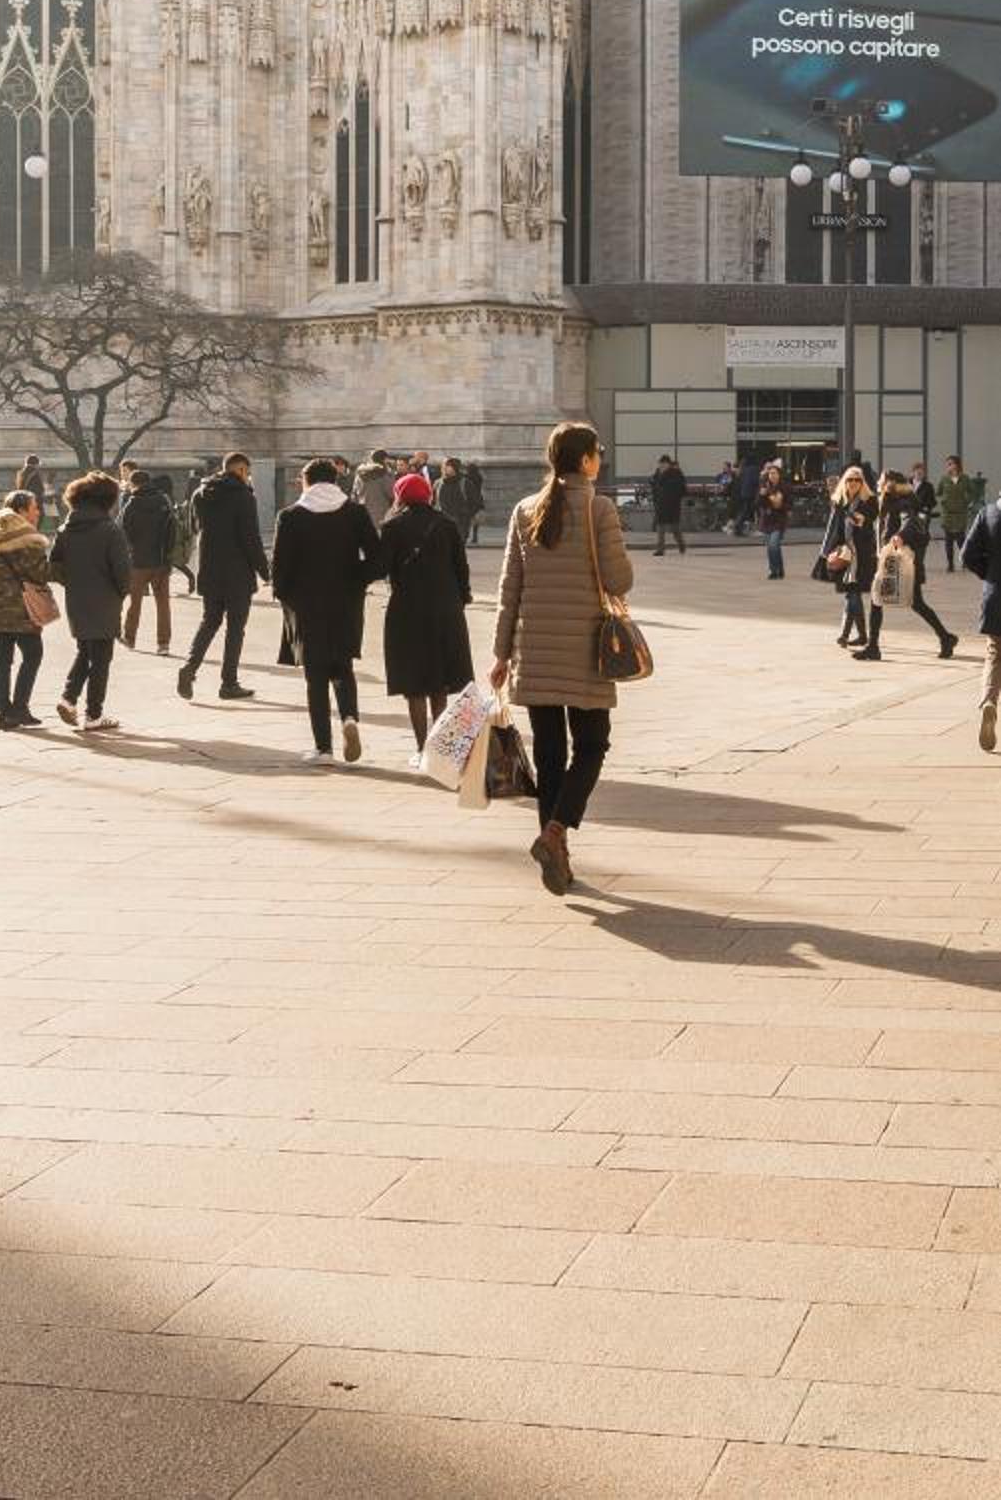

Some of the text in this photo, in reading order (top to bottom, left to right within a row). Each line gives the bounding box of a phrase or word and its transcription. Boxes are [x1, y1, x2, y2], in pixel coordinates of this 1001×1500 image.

[778, 7, 915, 35] Certi risvegli
[752, 37, 940, 62] possono capitare
